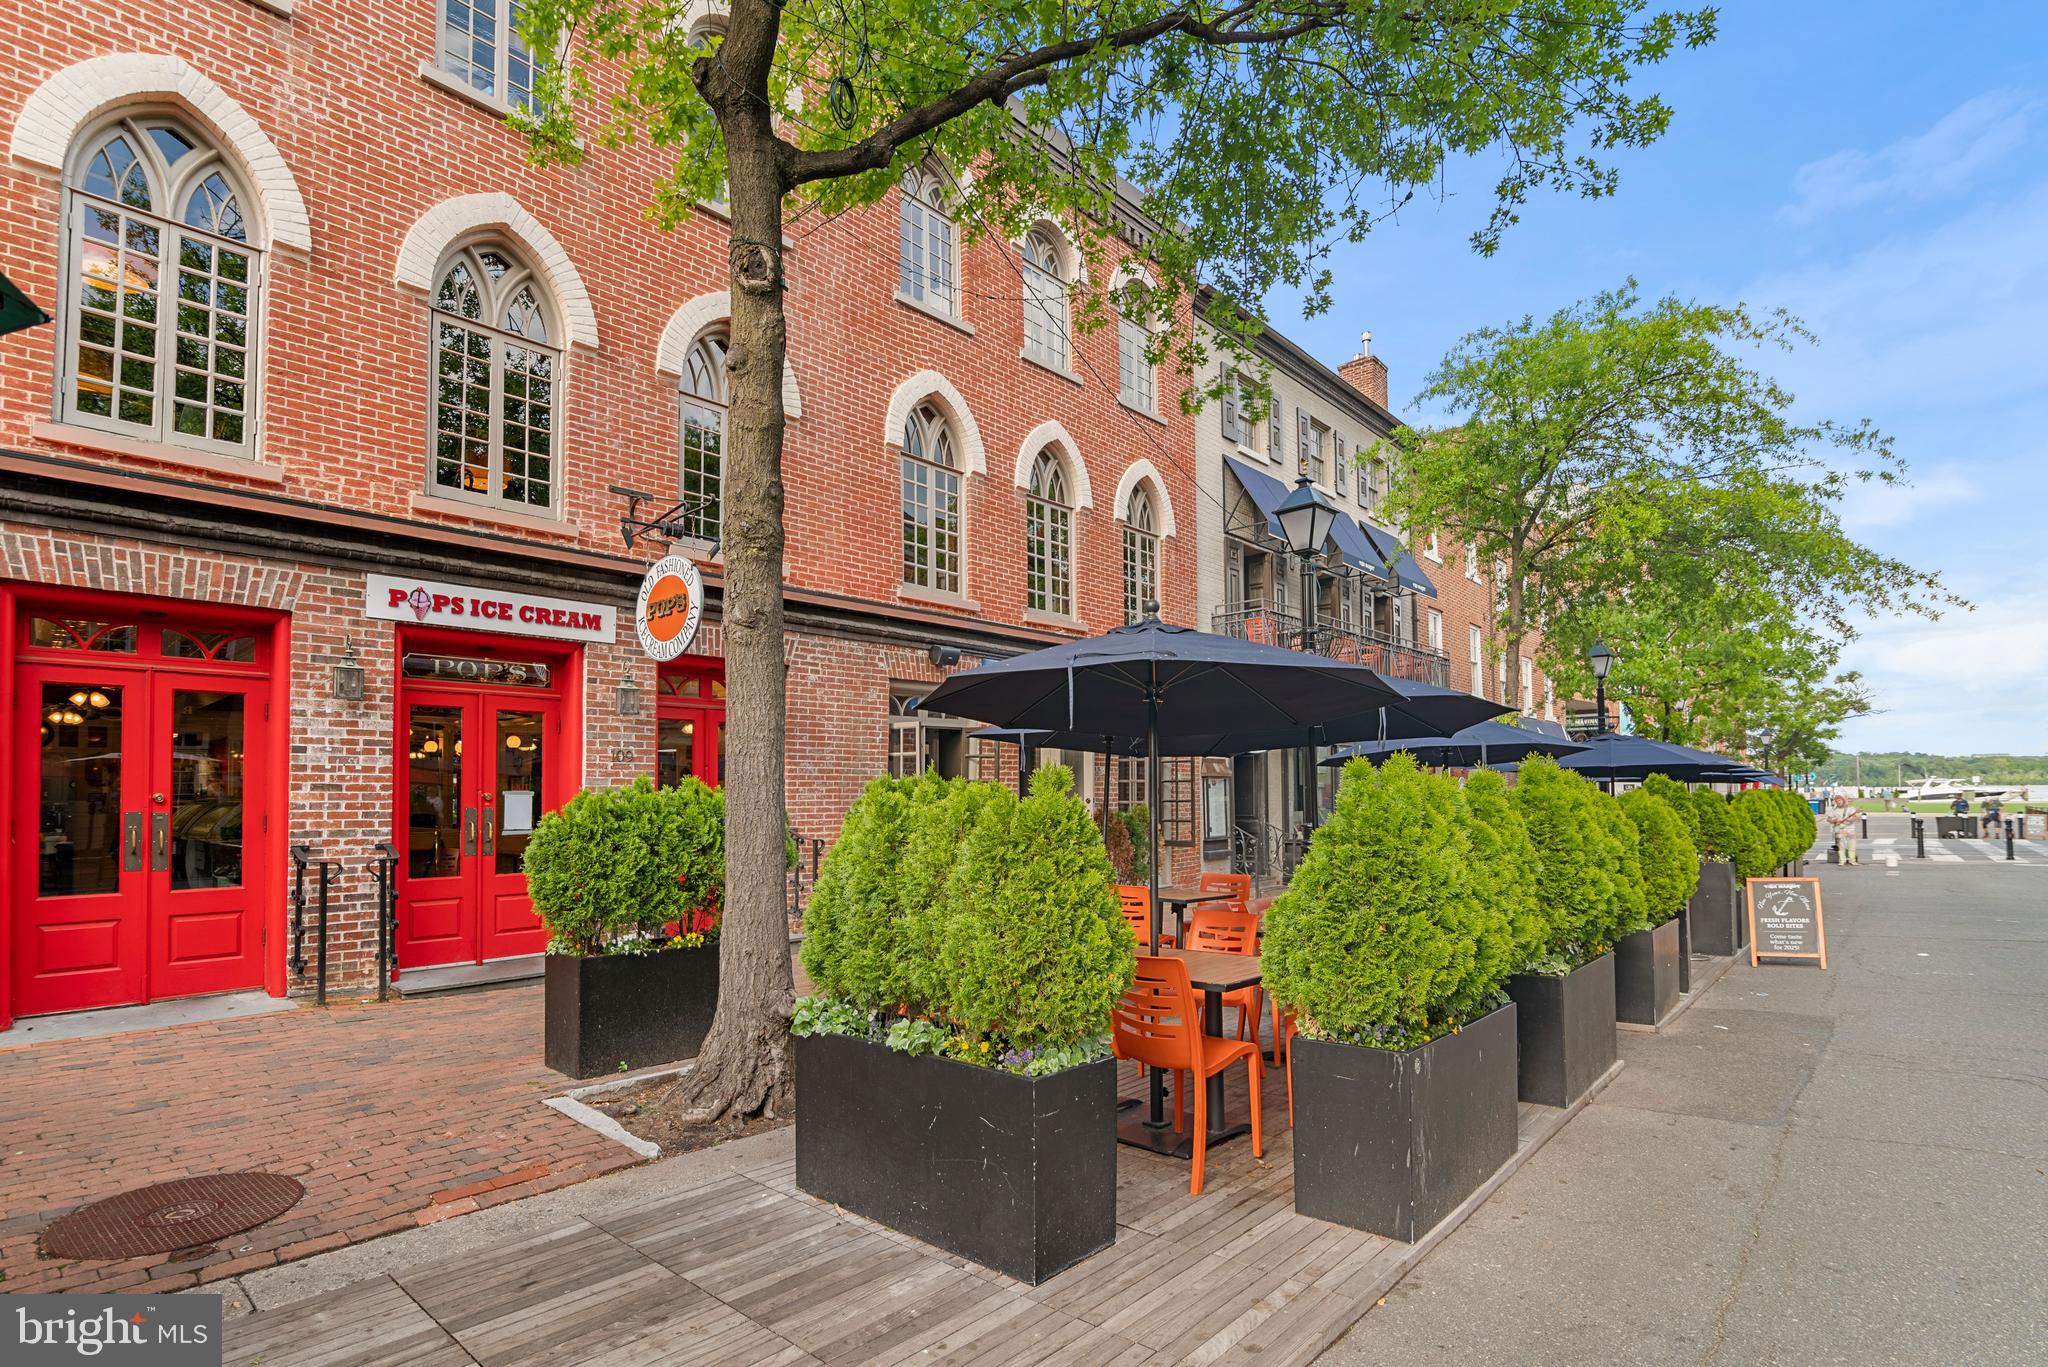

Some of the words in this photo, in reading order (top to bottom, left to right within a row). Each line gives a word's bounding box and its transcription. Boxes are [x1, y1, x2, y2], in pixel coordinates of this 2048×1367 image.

[641, 575, 654, 602] OLD
[655, 558, 695, 587] FASHIONED
[470, 598, 513, 621] ICE
[520, 605, 602, 631] CREAM
[638, 616, 647, 640] ICE
[644, 635, 668, 659] CREAM
[668, 601, 699, 657] COMPANY
[430, 658, 527, 681] POP'S
